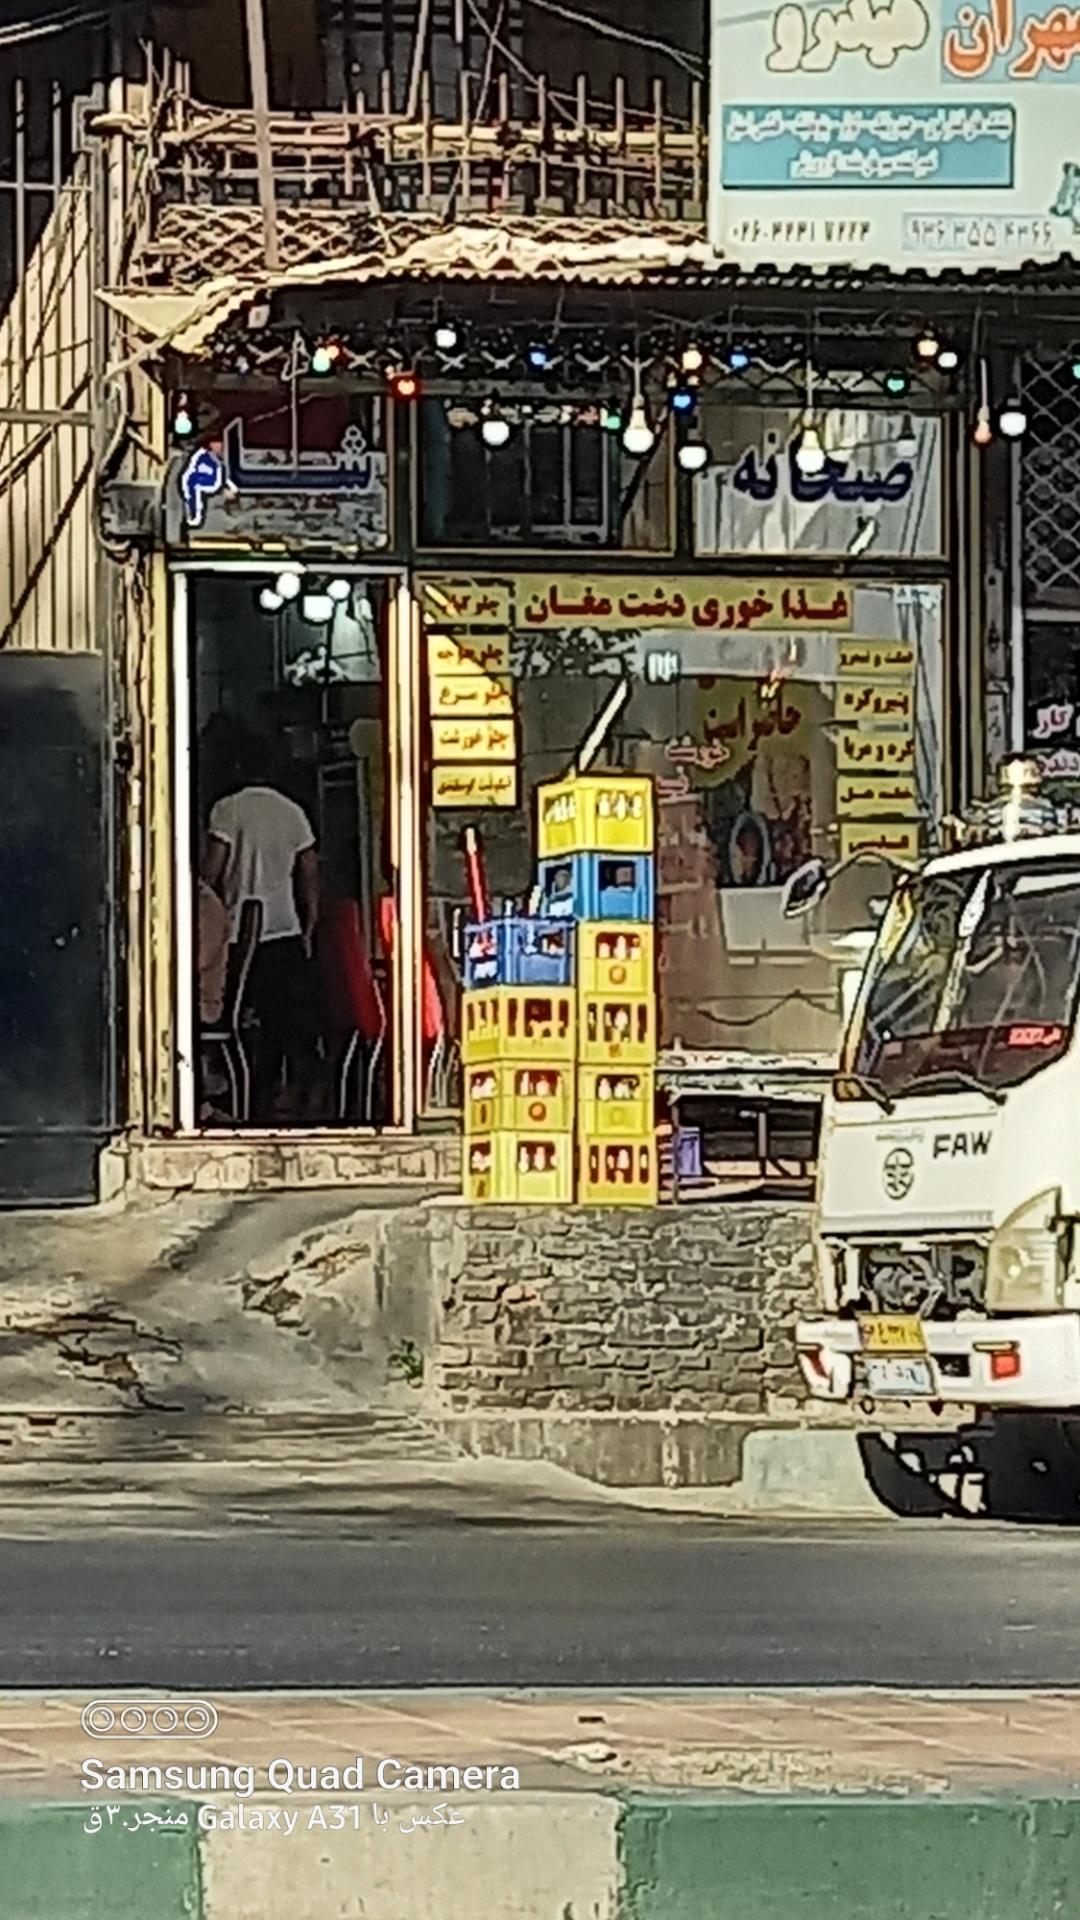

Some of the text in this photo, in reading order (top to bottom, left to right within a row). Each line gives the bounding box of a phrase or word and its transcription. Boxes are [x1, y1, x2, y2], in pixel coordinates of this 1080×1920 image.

[945, 0, 1080, 82] هران
[182, 416, 373, 527] شام
[523, 584, 848, 630] غذا خوری دشت مغان
[932, 1129, 993, 1159] FAW
